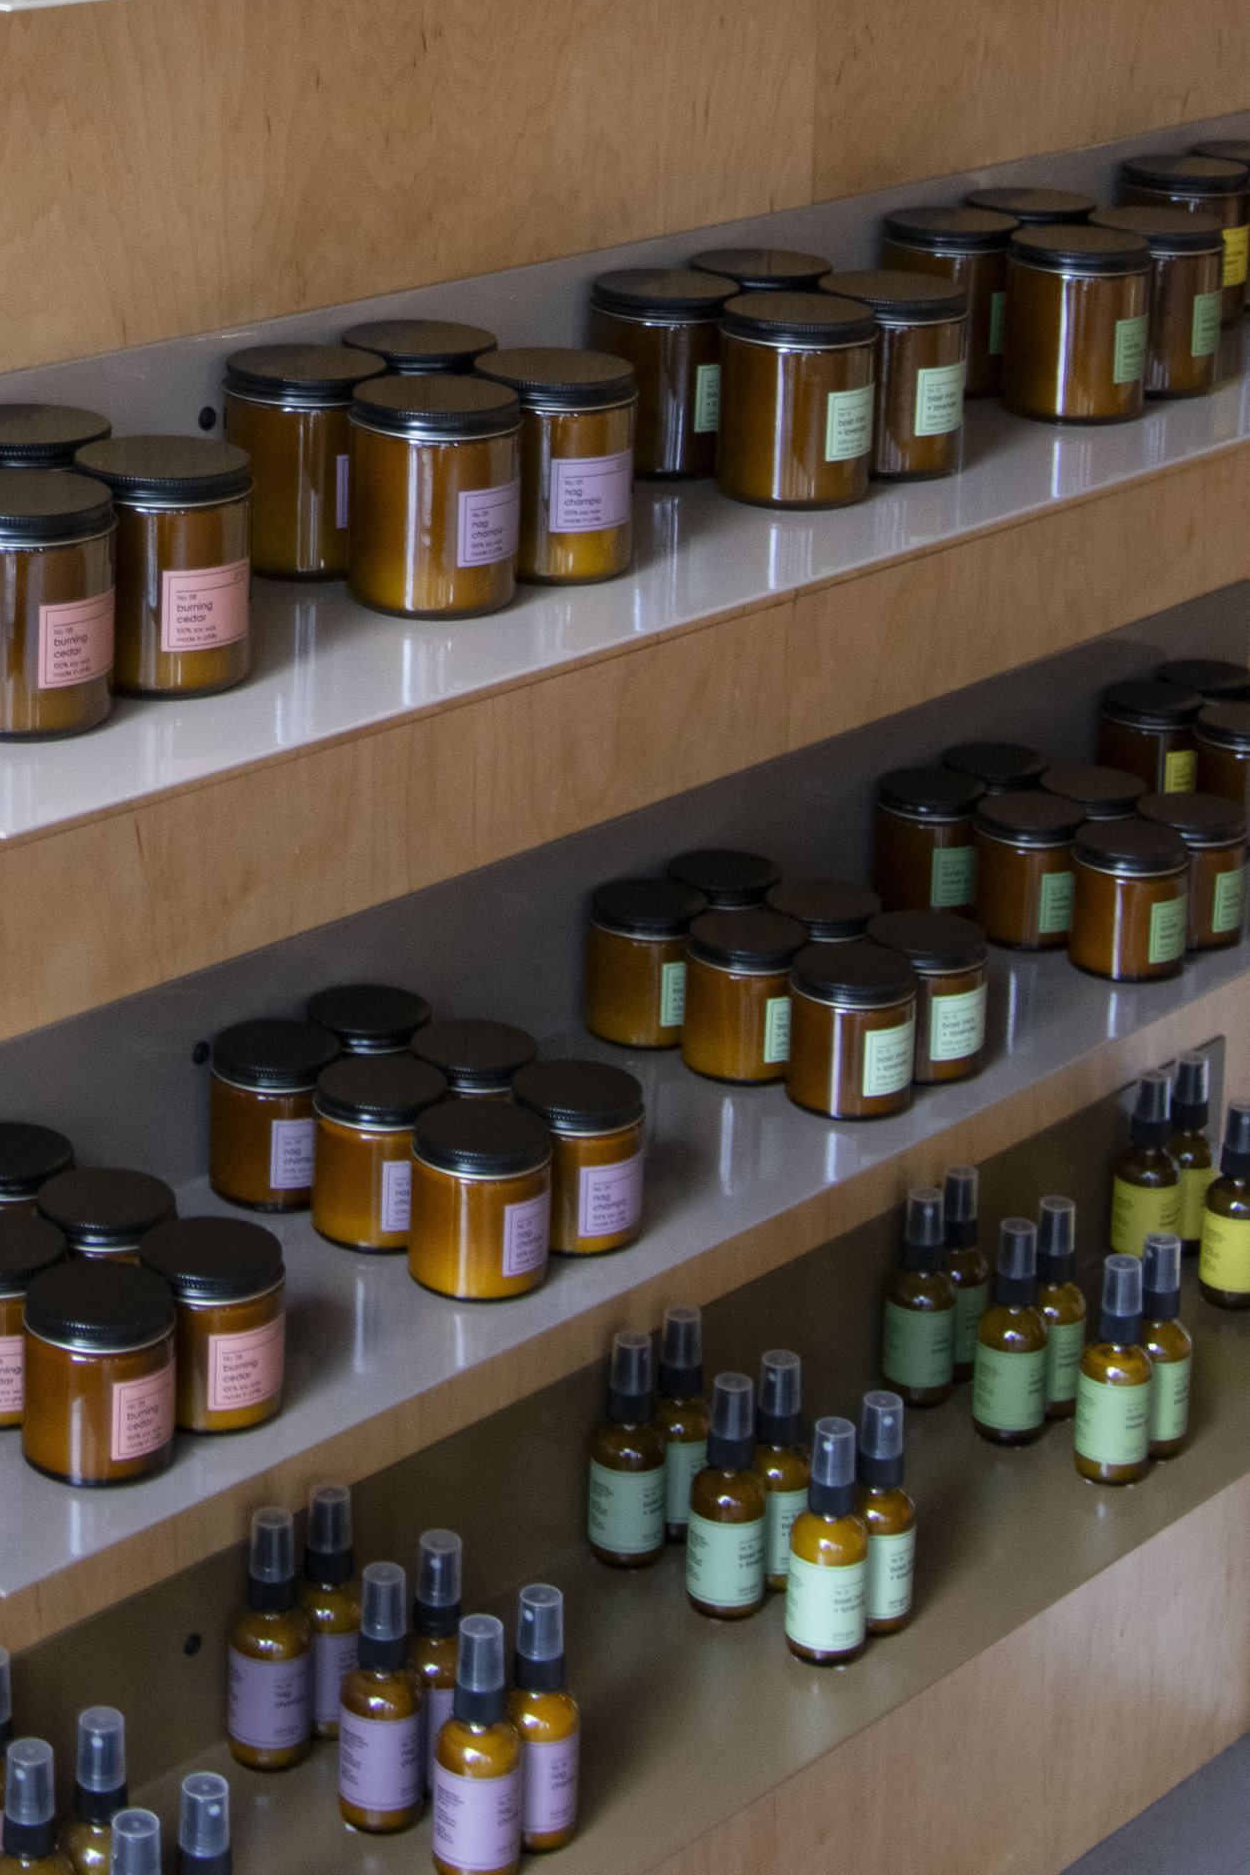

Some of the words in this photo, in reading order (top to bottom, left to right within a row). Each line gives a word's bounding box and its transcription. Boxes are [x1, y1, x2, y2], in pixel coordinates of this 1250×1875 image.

[565, 489, 583, 497] nag
[565, 497, 602, 506] champa
[472, 520, 489, 528] nag
[177, 601, 213, 613] burning
[176, 614, 207, 624] cedar
[54, 633, 88, 647] burning
[53, 647, 82, 659] cedar
